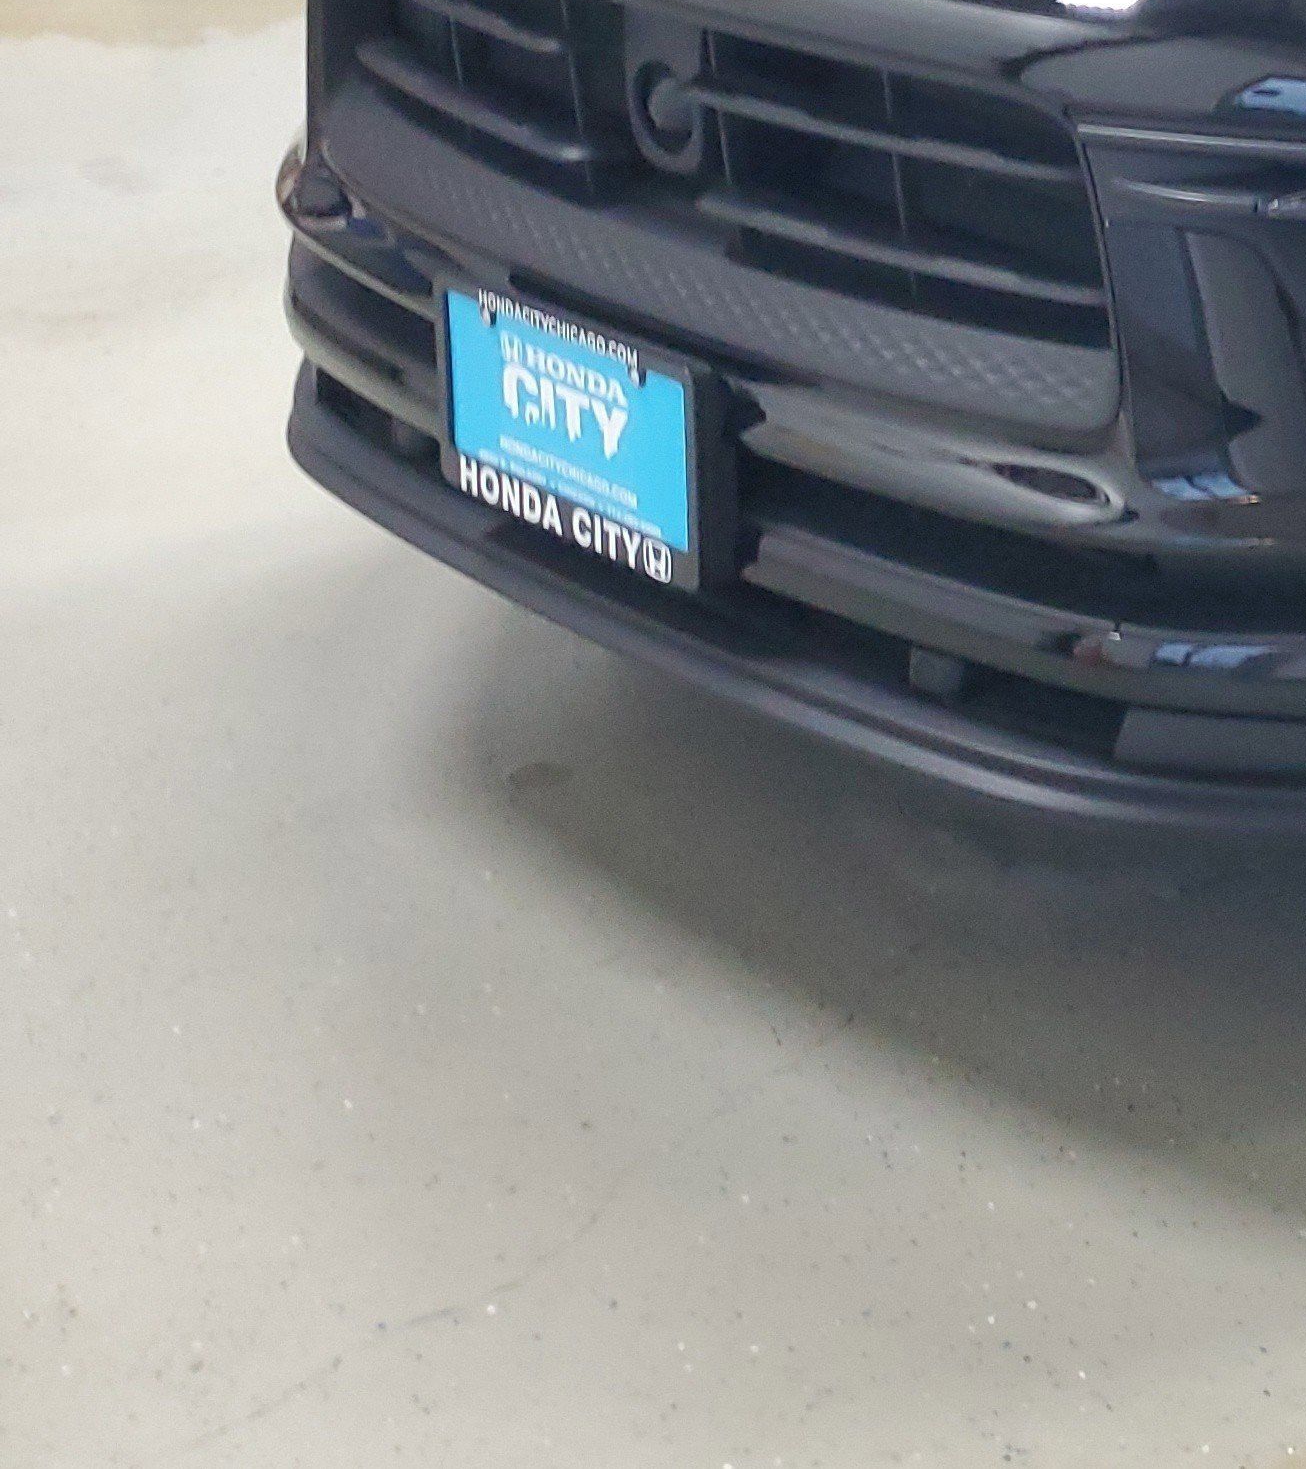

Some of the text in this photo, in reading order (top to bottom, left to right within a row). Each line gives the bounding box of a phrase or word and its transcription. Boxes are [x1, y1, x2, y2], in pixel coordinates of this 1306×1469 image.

[502, 363, 628, 460] CITY
[525, 345, 628, 408] HONDA
[459, 455, 563, 535] HONDA
[571, 507, 643, 569] CITY
